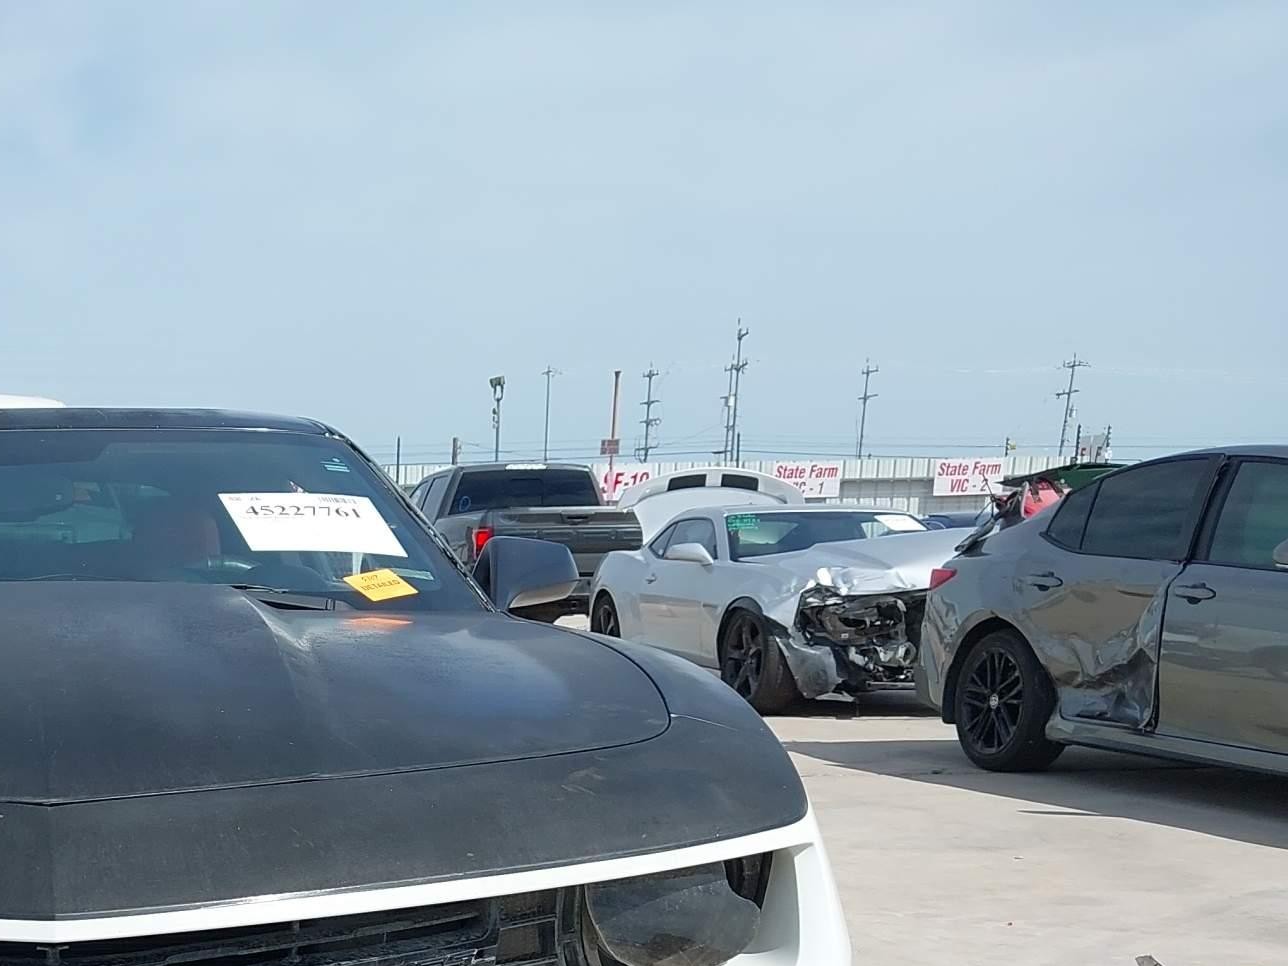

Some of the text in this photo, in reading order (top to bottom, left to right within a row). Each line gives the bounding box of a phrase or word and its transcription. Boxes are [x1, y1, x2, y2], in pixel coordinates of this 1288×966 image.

[775, 464, 839, 479] State Farm
[937, 461, 1002, 477] State Farm
[950, 478, 969, 492] VIC
[979, 478, 988, 492] 2
[245, 505, 361, 518] 45227761
